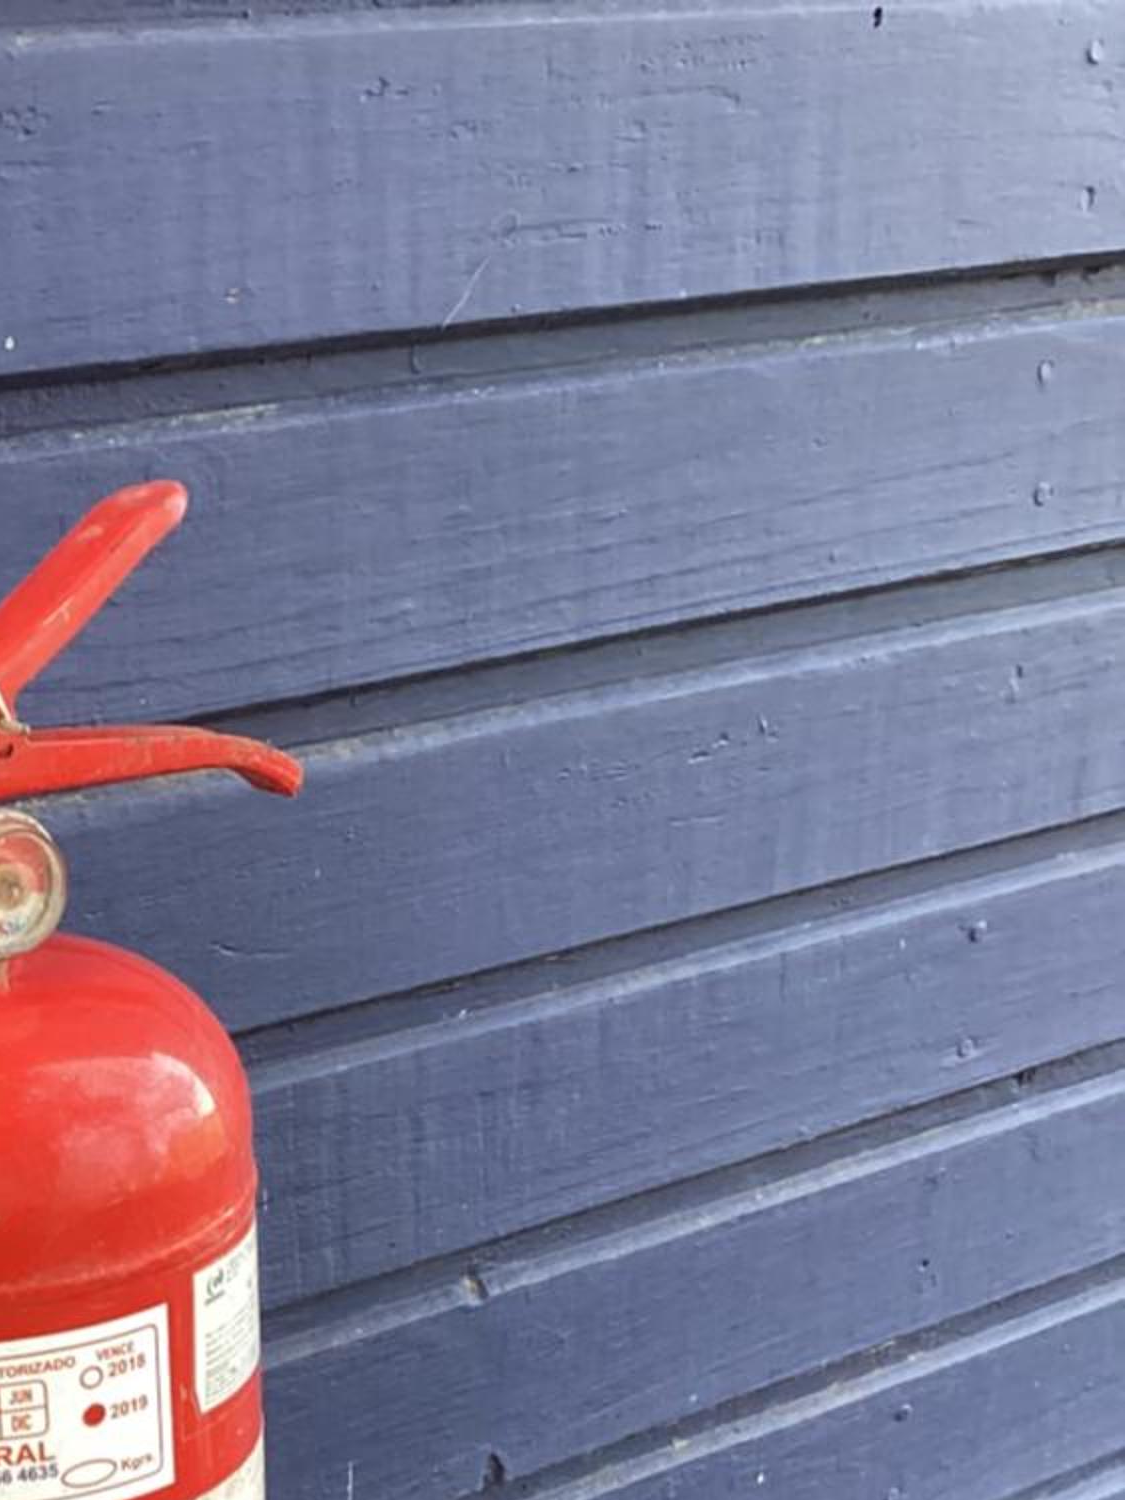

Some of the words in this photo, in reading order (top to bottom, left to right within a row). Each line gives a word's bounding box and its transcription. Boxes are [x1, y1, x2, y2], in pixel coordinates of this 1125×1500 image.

[95, 1341, 135, 1361] VENCE
[107, 1353, 147, 1378] 2018
[9, 1389, 33, 1405] JUN
[109, 1394, 149, 1419] 2019
[10, 1414, 33, 1432] DIC
[16, 1463, 59, 1482] 4635
